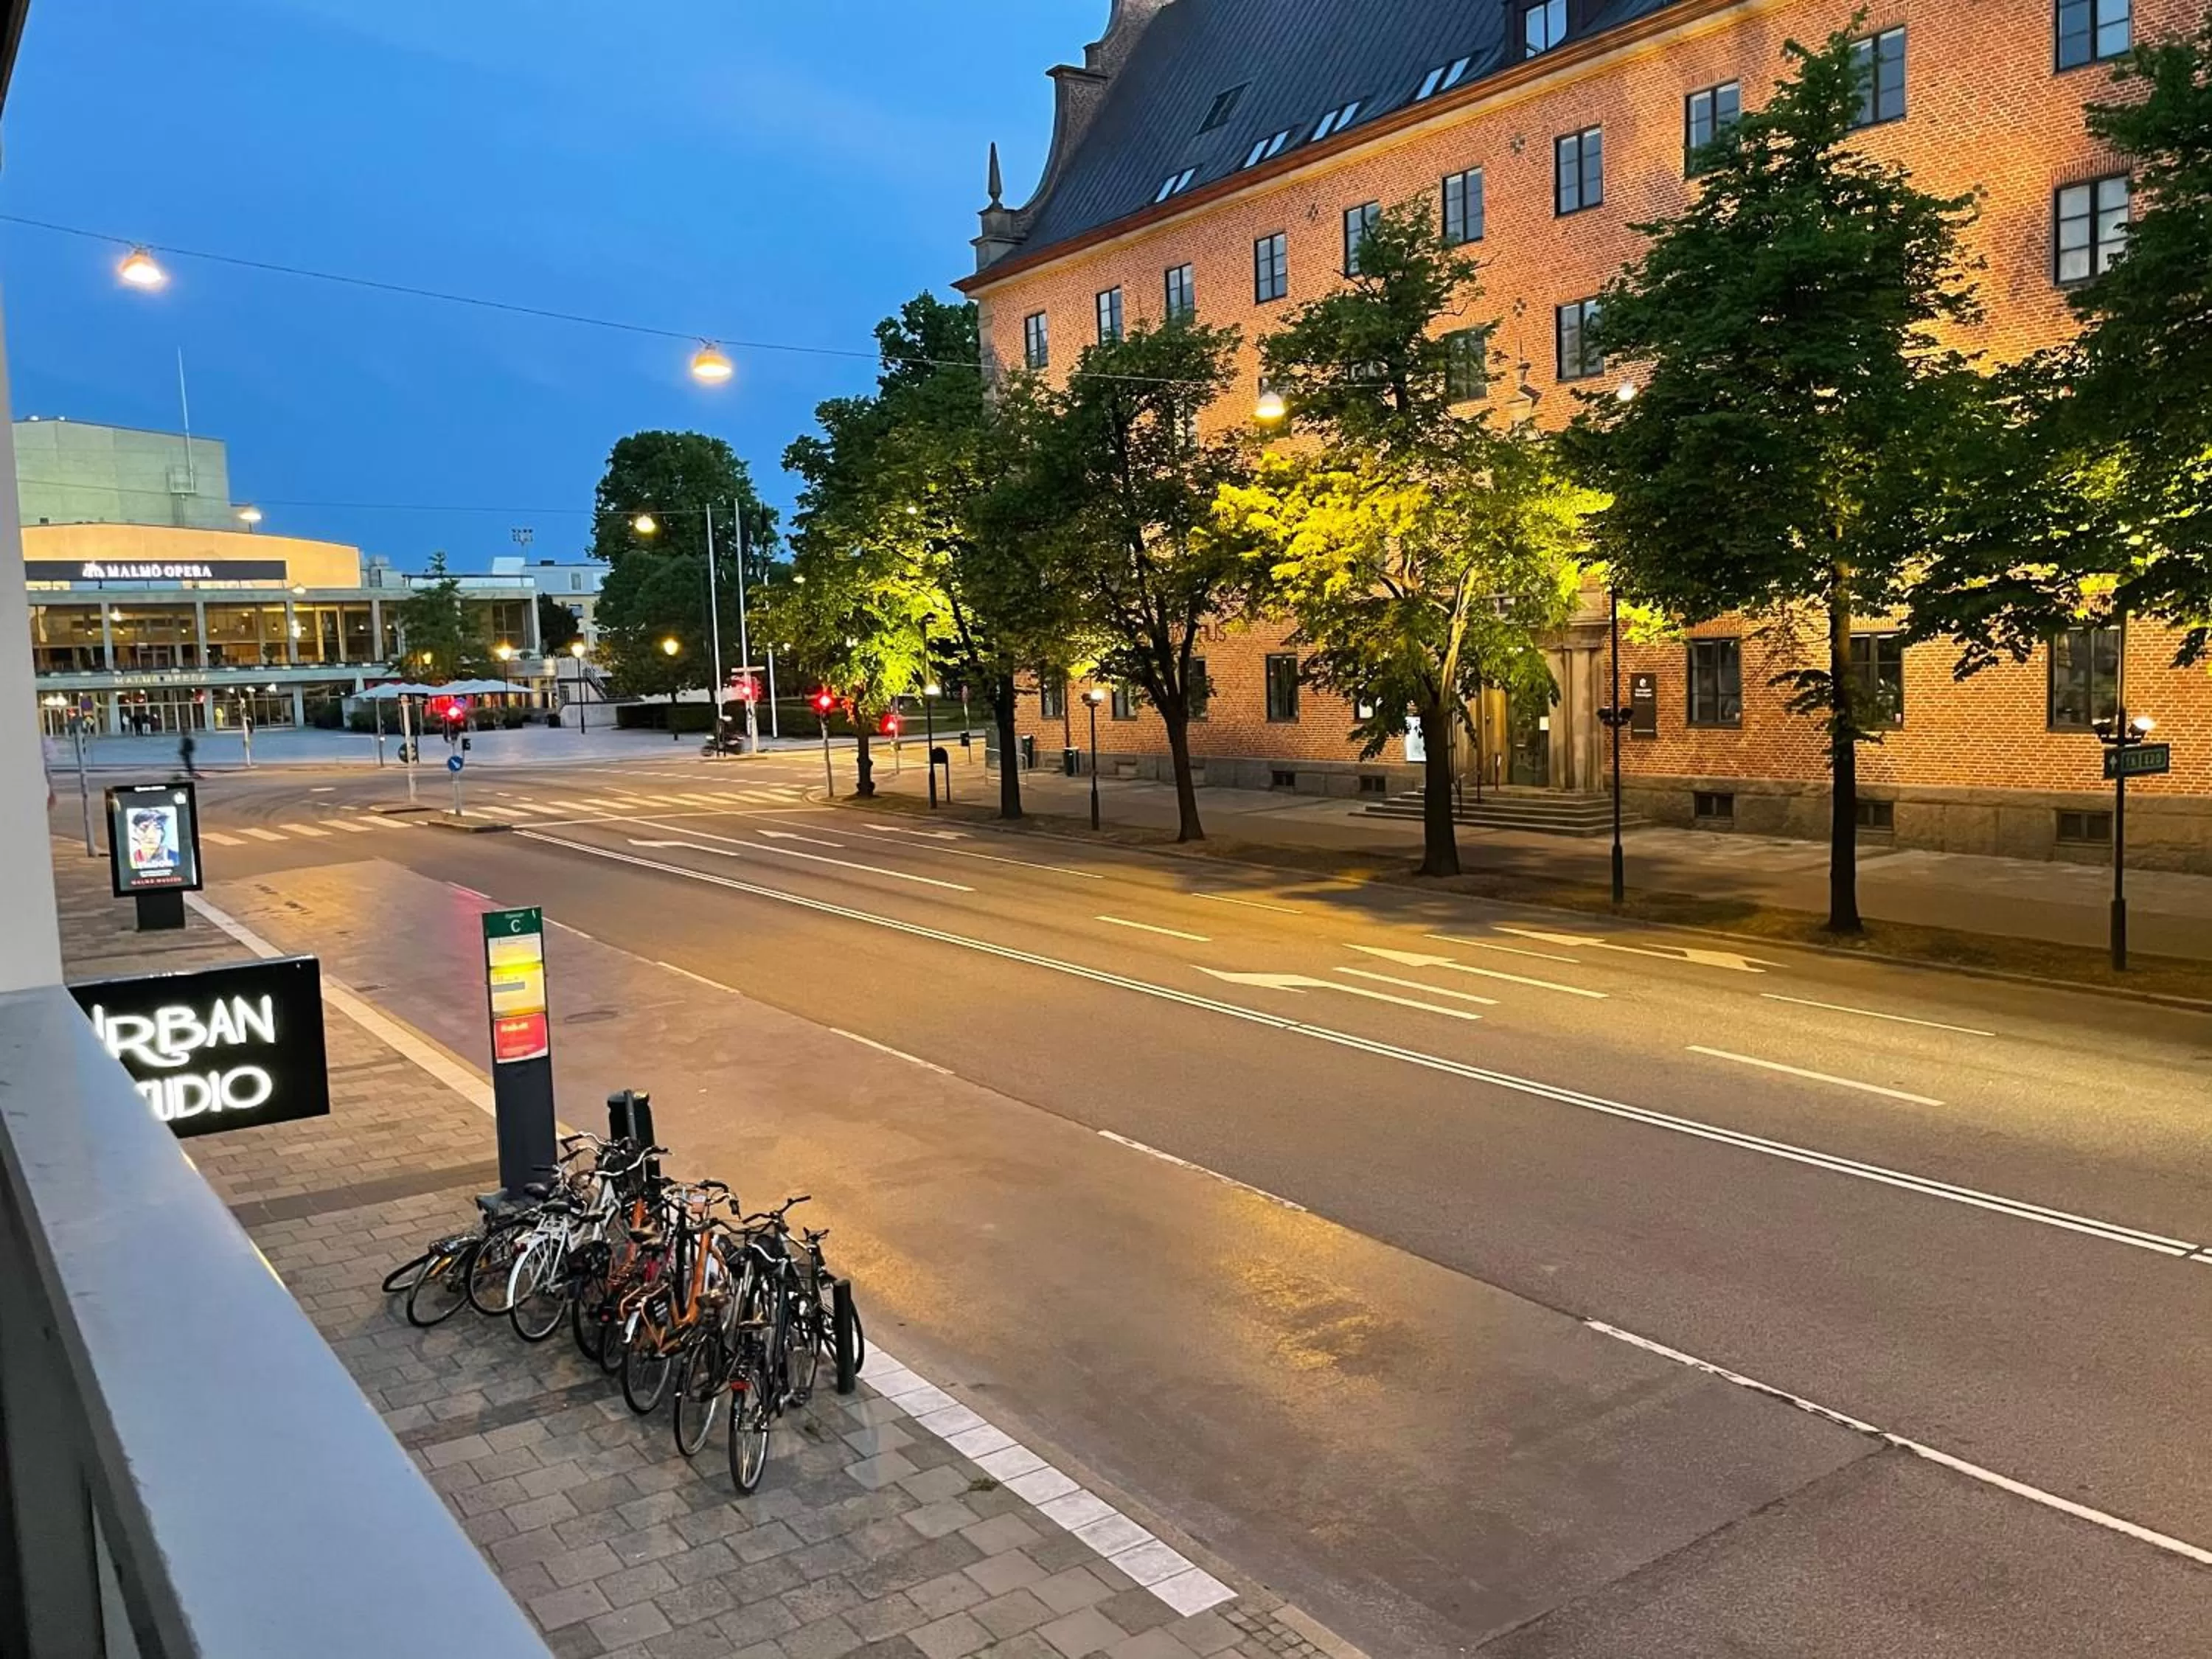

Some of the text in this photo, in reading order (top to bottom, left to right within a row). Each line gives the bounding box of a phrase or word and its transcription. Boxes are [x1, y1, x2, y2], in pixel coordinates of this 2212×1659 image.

[106, 563, 212, 577] MALMÖ OPERA
[510, 919, 521, 933] C
